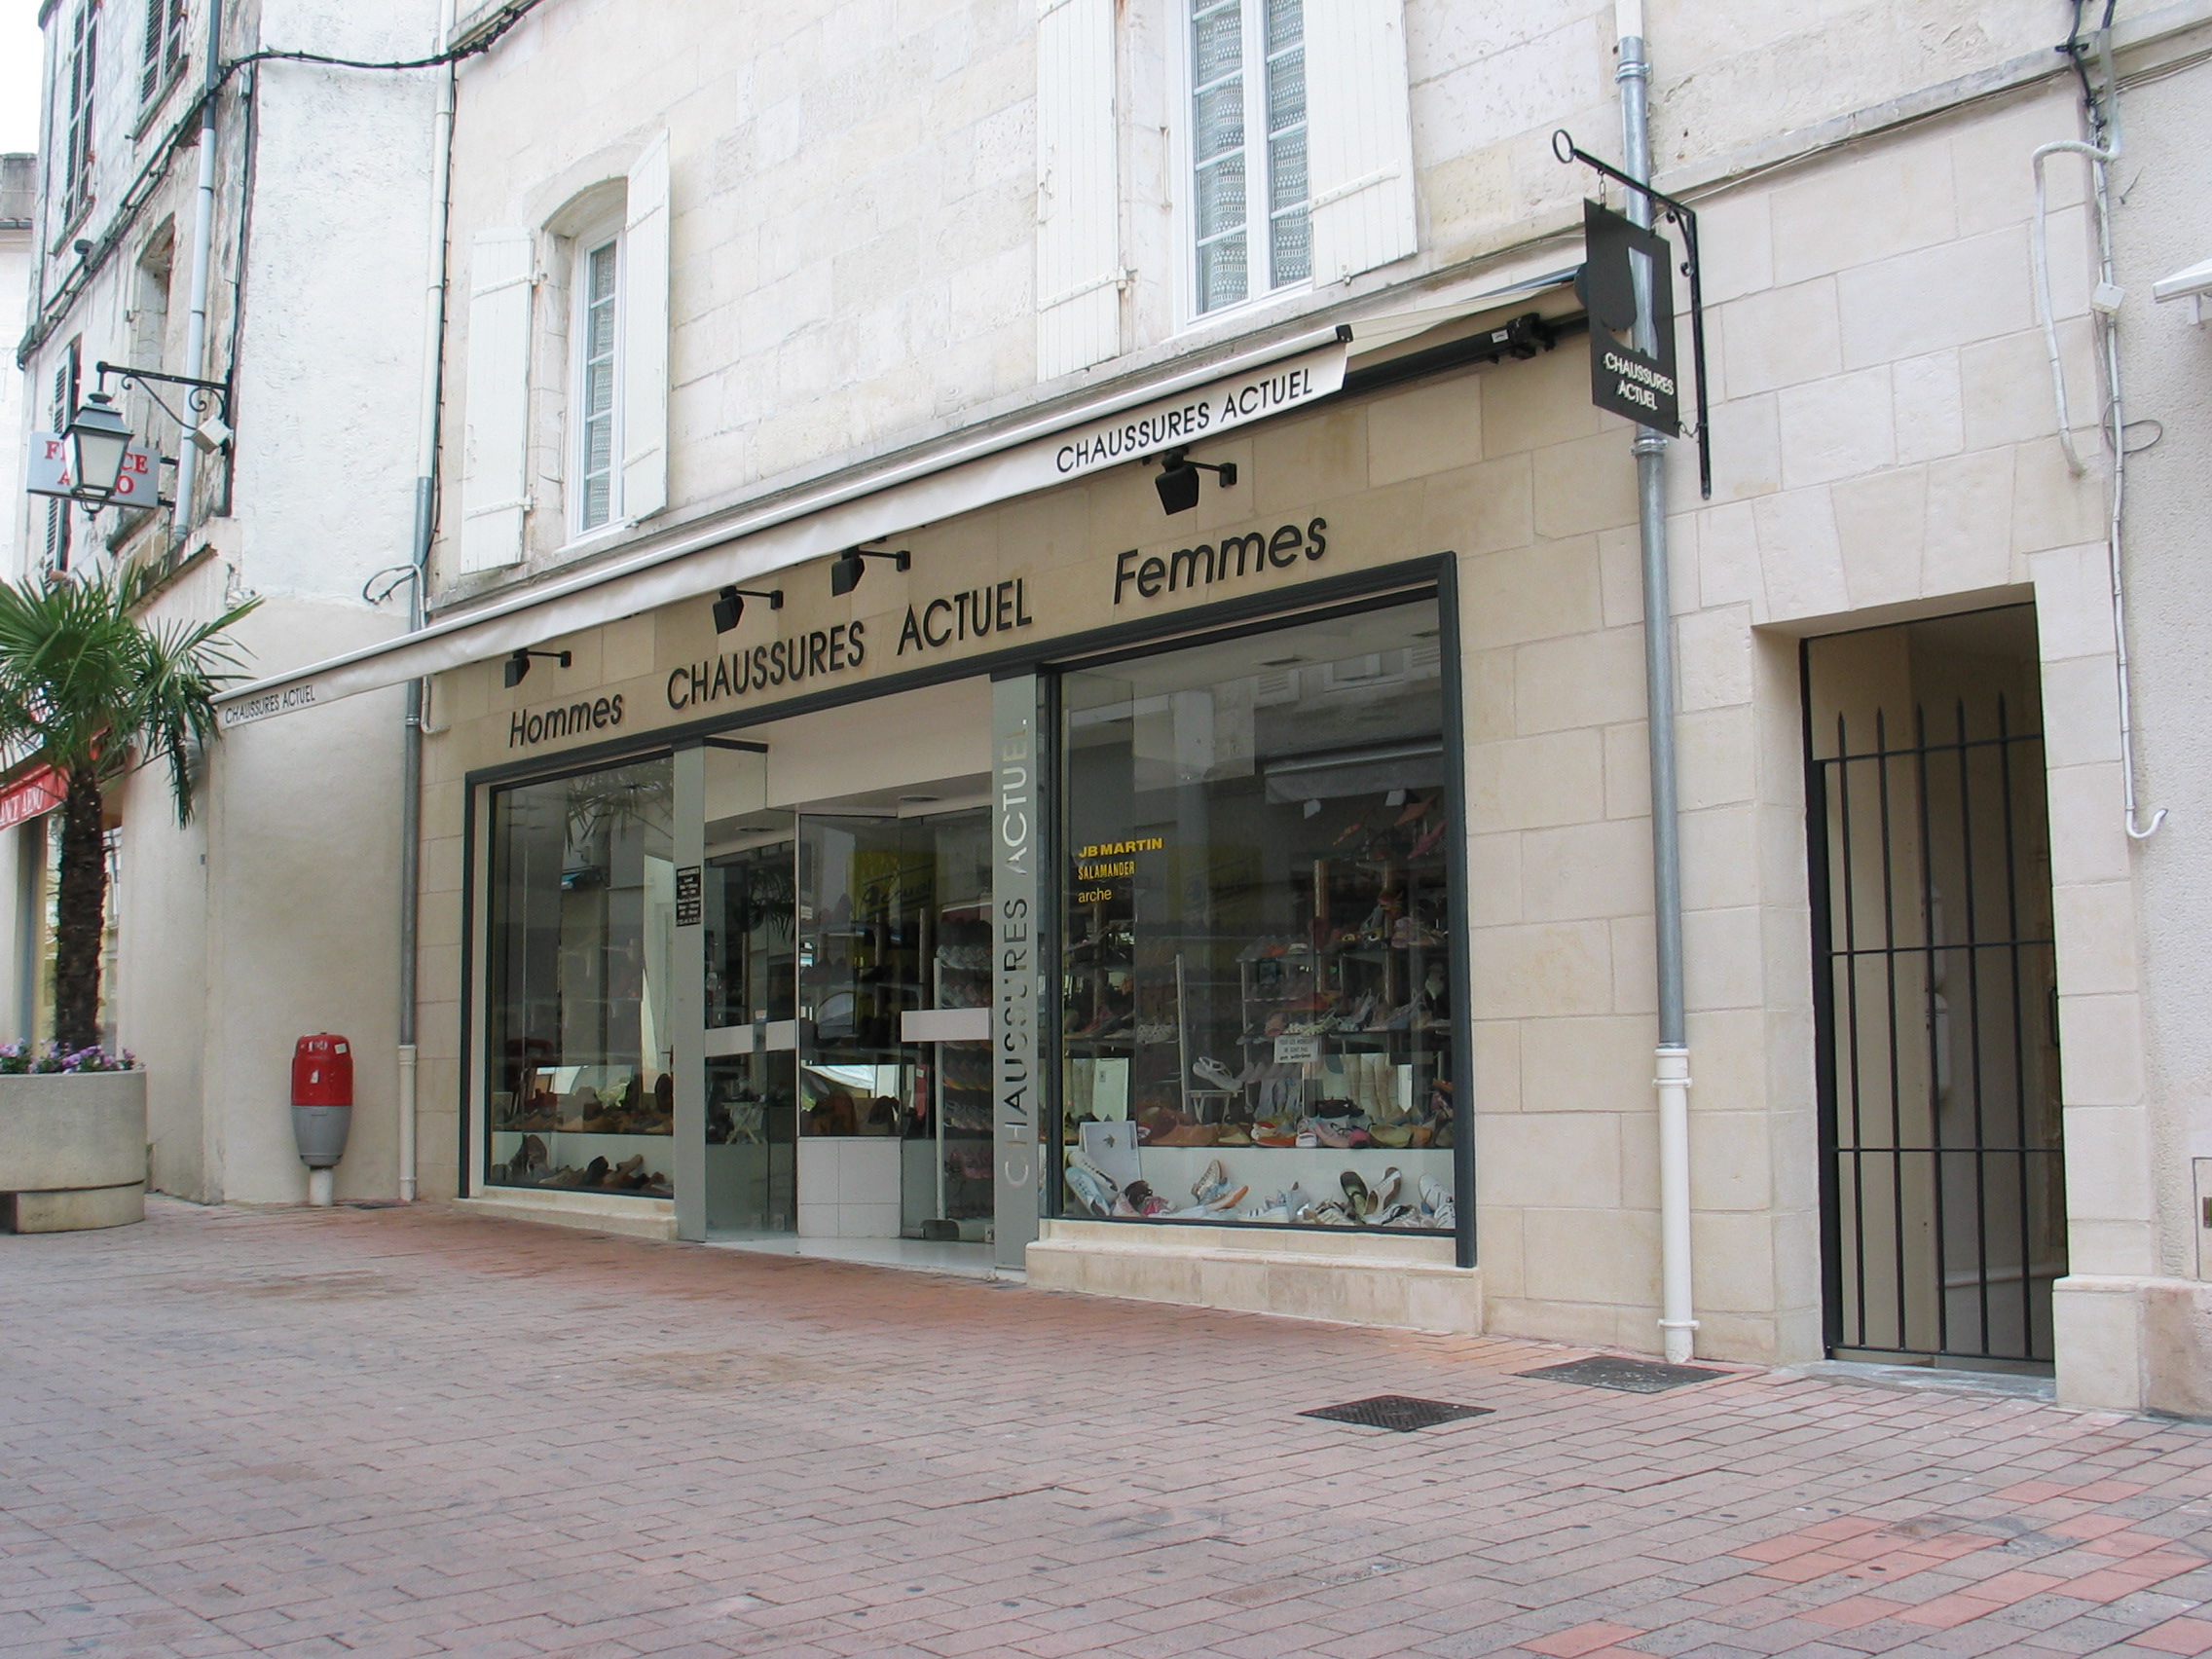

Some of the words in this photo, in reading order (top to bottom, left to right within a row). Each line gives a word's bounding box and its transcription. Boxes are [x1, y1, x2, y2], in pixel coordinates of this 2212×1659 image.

[1604, 351, 1675, 396] CHAUSSURES
[1617, 379, 1659, 411] ACTUEL
[1056, 401, 1210, 473] CHAUSSURES
[1220, 368, 1313, 424] ACTUEL
[1113, 517, 1327, 606] Femmes
[667, 620, 865, 711] CHAUSSURES
[897, 577, 1032, 656] ACTUEL
[225, 693, 280, 724] CHAUSSURES
[282, 684, 315, 709] ACTUEL
[509, 692, 623, 748] Hommes
[1002, 718, 1027, 875] ACTUEL
[1078, 861, 1135, 880] SALAMANDER
[1100, 837, 1163, 856] MARTIN
[1078, 887, 1112, 903] arche
[1004, 898, 1029, 1187] CHAUSSURES
